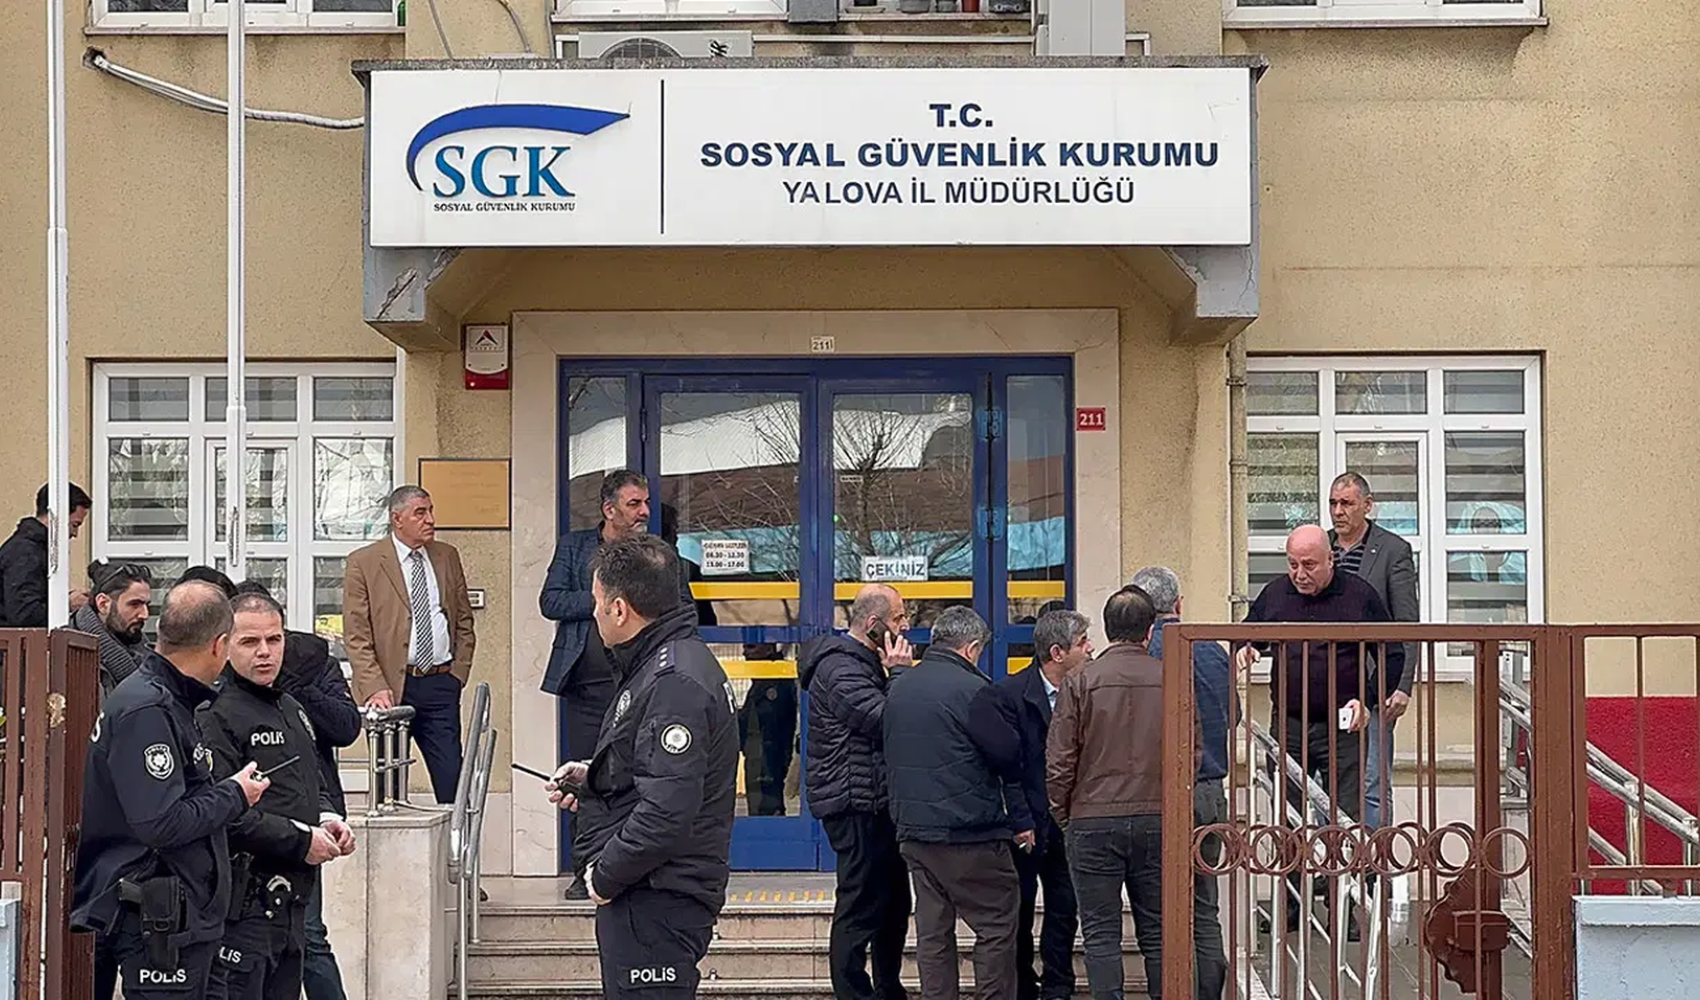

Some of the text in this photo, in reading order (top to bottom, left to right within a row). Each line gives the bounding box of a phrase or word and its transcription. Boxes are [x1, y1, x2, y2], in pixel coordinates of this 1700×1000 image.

[928, 102, 993, 128] T.C.
[700, 136, 1218, 168] SOSYAL GÜVENLİK KURUMU
[432, 145, 576, 199] SGK
[782, 176, 1134, 204] YALOVA İL MÜDÜRLÜĞÜ
[433, 201, 576, 212] SOSYAL GÜVENLİK KURUMU
[1080, 413, 1103, 426] 211
